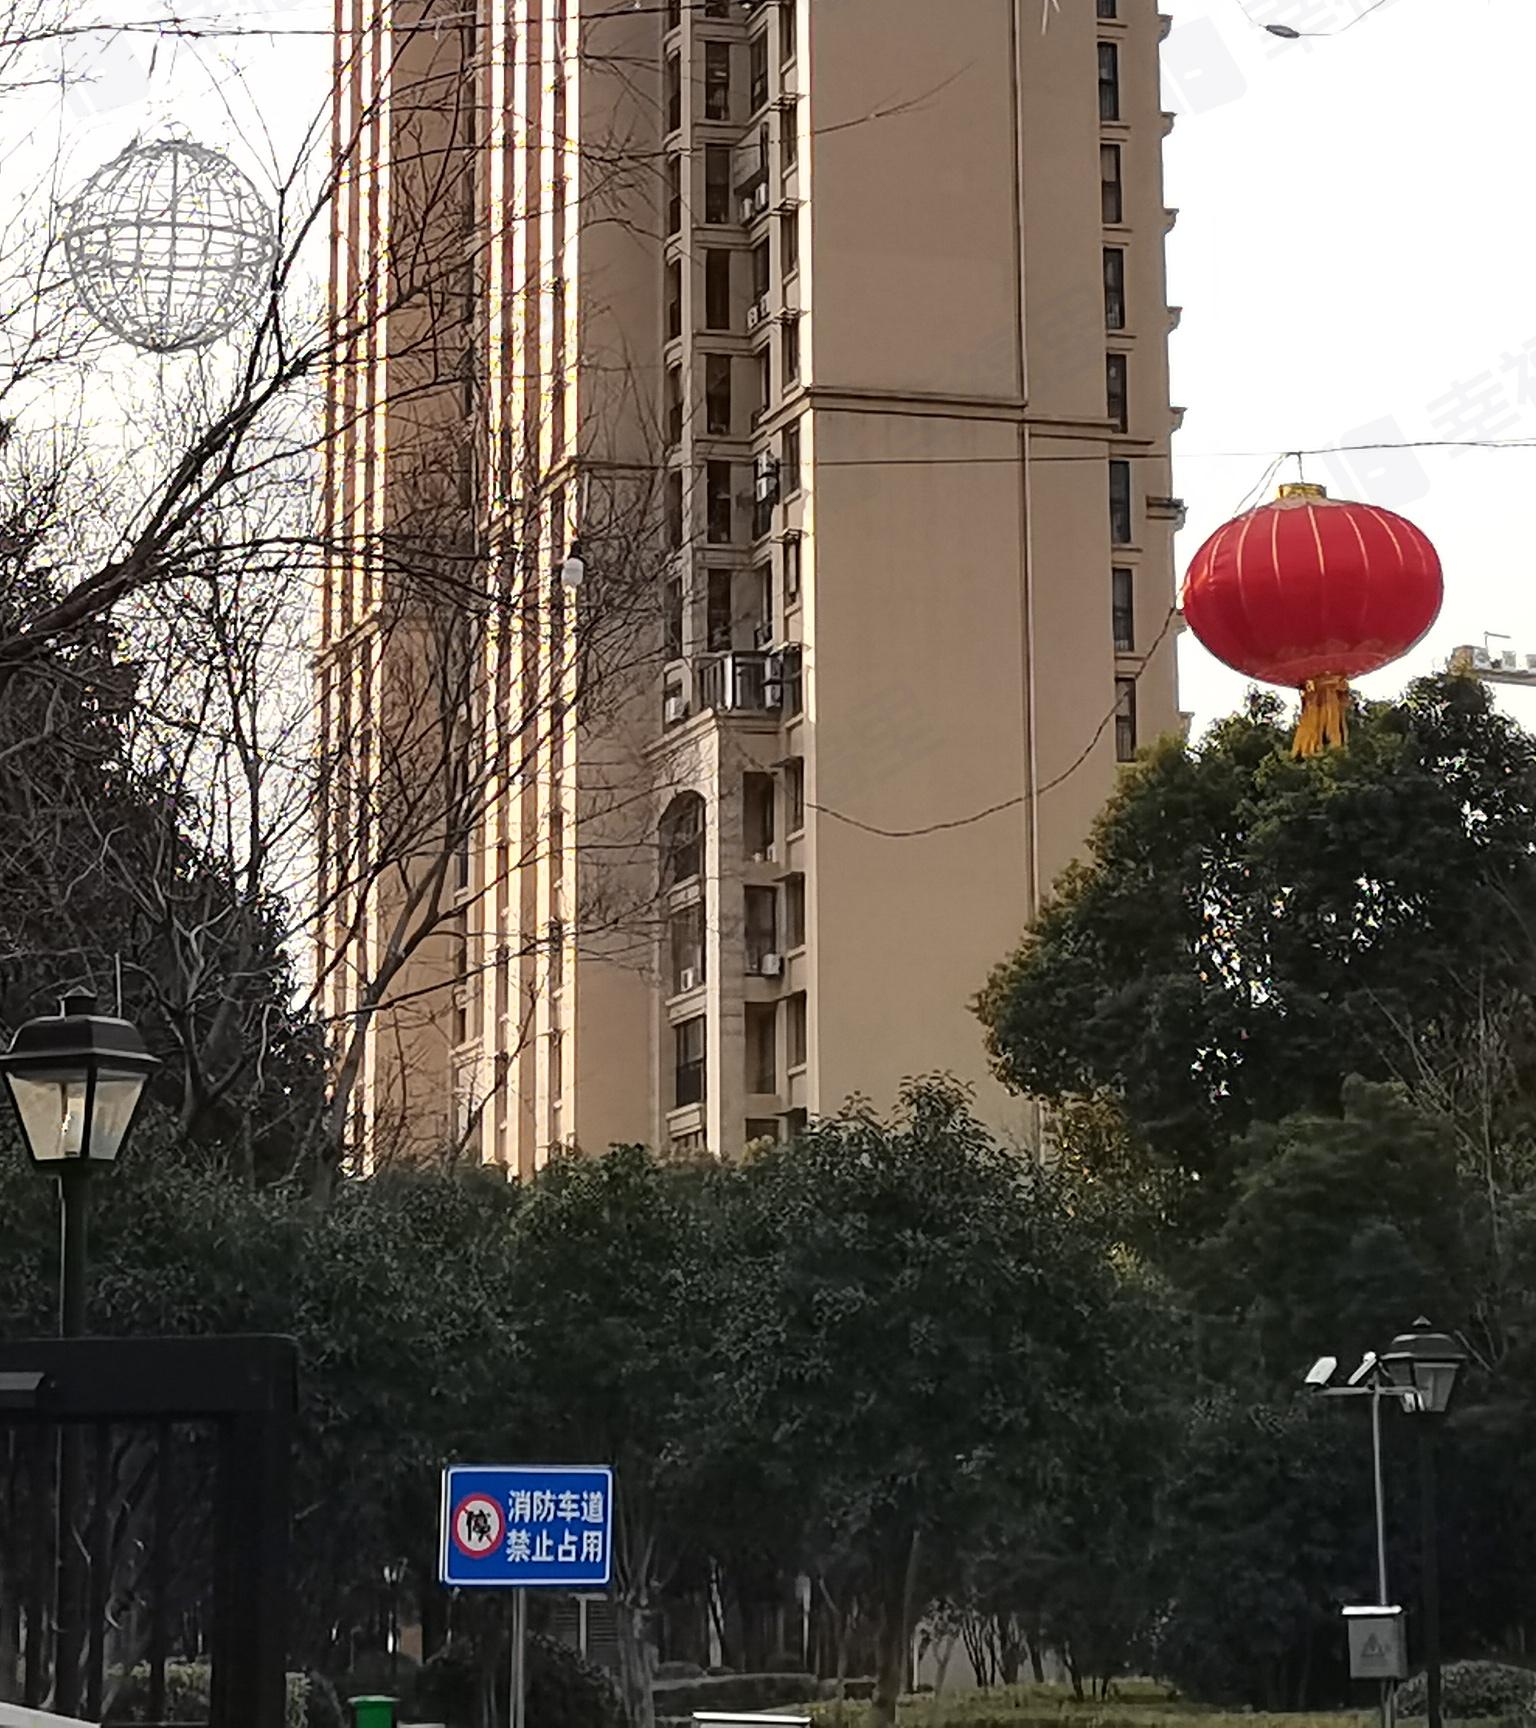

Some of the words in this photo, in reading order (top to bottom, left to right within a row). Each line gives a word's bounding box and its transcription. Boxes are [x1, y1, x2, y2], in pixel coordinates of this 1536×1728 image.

[508, 1489, 604, 1524] 消防车道
[506, 1528, 604, 1563] 禁止占用
